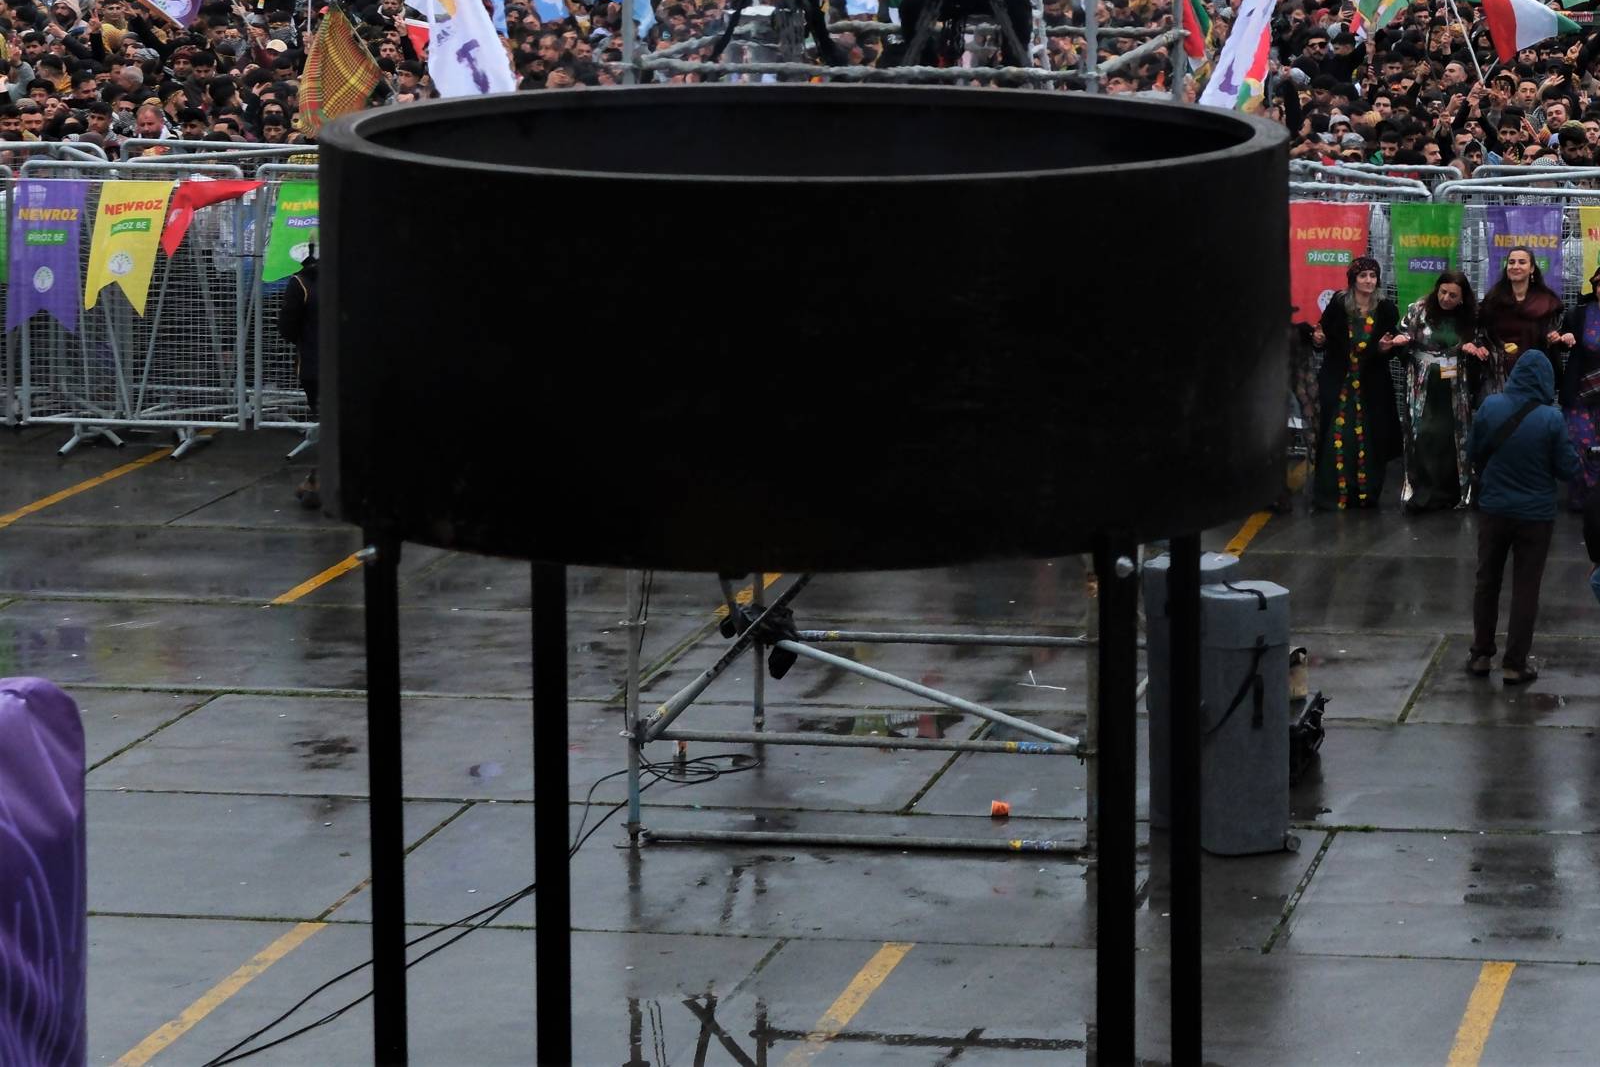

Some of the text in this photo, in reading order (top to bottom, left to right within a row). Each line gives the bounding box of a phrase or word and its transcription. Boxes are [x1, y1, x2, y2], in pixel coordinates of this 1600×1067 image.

[103, 199, 164, 216] NEWROZ
[281, 201, 320, 211] NEW
[18, 207, 79, 222] NEWROZ
[136, 221, 148, 230] BE
[54, 232, 65, 242] BE
[1296, 226, 1363, 241] NEWROZ
[1494, 234, 1559, 249] NEWROZ
[1338, 252, 1350, 263] BE
